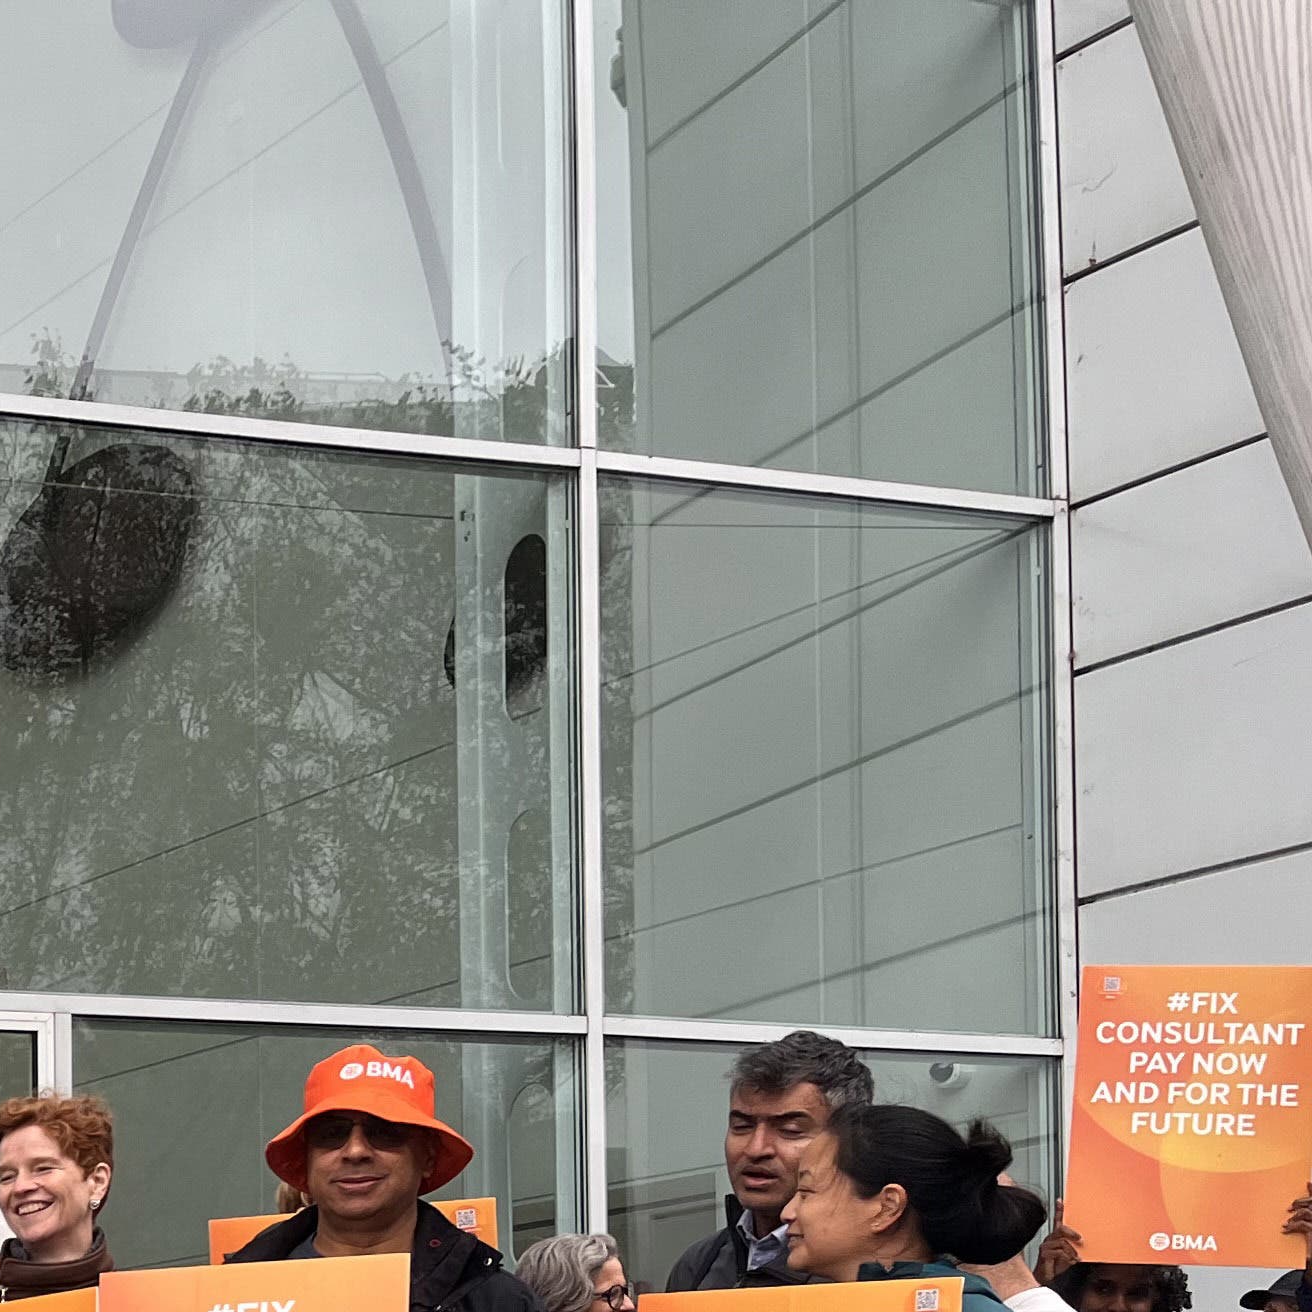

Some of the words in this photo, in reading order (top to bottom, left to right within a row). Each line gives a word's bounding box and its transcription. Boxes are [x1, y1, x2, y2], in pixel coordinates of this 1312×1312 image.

[1168, 993, 1238, 1013] #FIX
[1097, 1022, 1304, 1044] CONSULTANT
[1130, 1052, 1185, 1073] PAY
[1193, 1053, 1267, 1074] NOW
[367, 1062, 414, 1088] BMA
[1091, 1082, 1159, 1103] AND
[1168, 1083, 1229, 1104] FOR
[1237, 1084, 1298, 1106] THE
[1132, 1112, 1255, 1135] FUTURE
[1172, 1235, 1216, 1250] BMA
